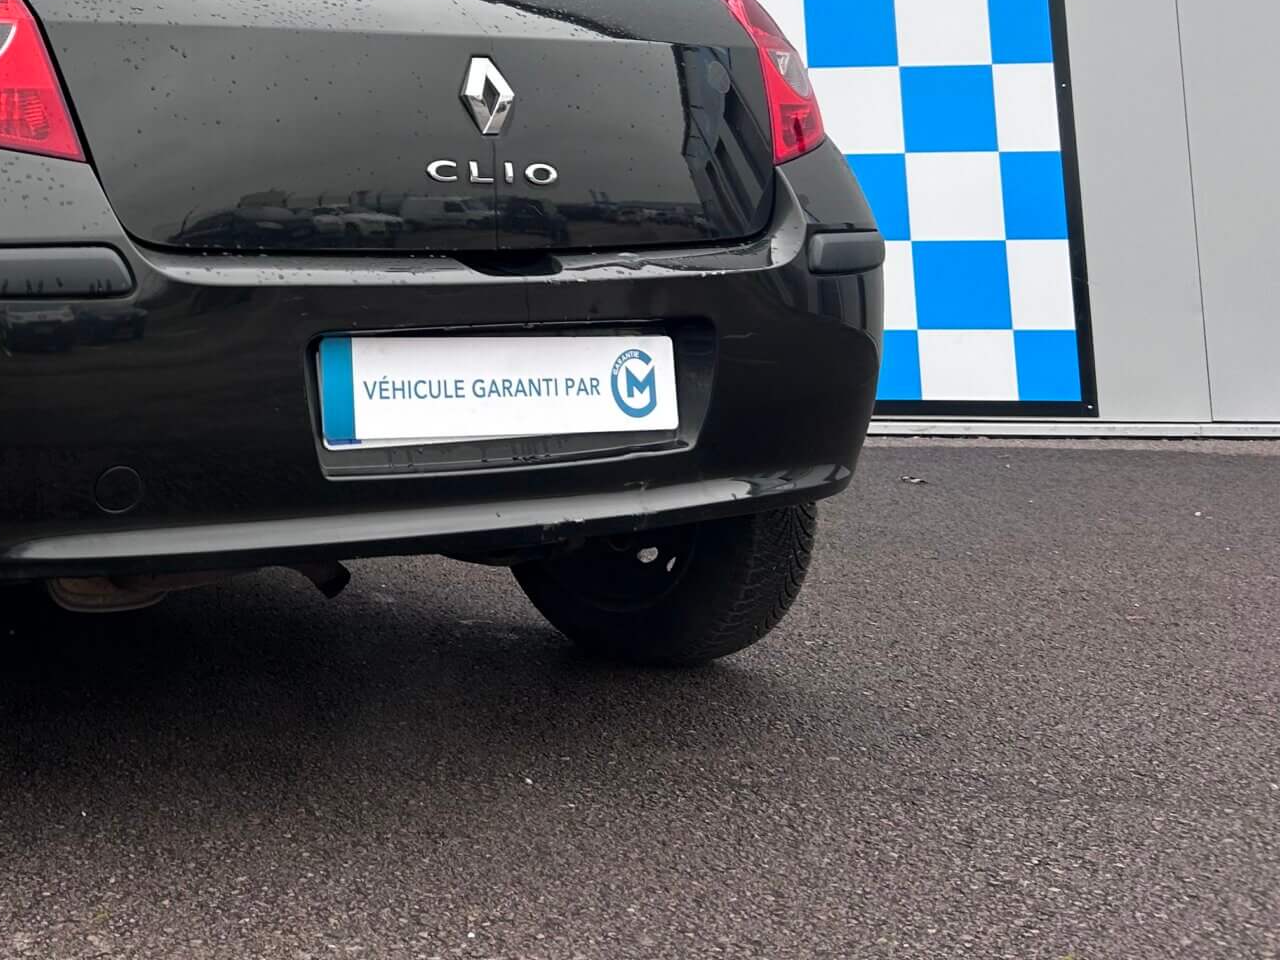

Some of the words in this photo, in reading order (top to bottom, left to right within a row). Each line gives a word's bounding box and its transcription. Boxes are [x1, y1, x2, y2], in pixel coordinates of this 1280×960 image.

[426, 159, 558, 185] CLIO
[362, 375, 466, 400] VÉHICULE
[471, 378, 558, 399] GARANTI
[565, 376, 601, 396] PAR
